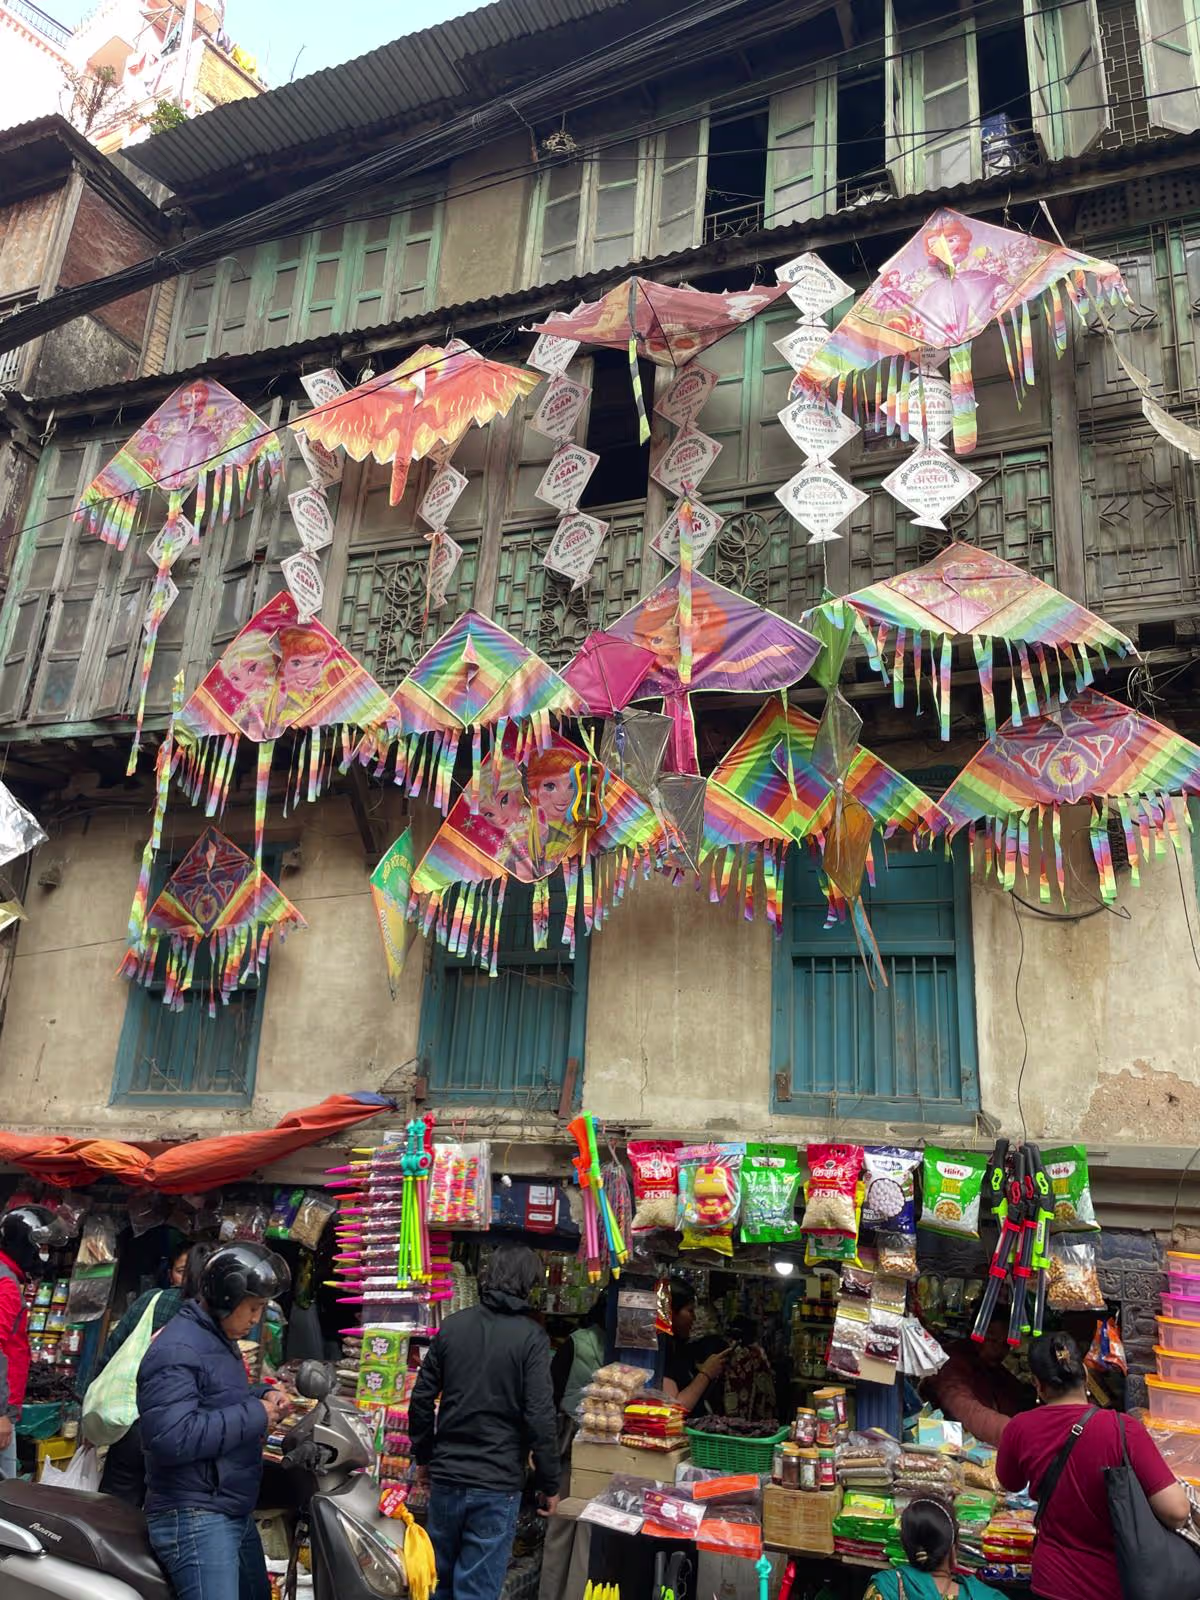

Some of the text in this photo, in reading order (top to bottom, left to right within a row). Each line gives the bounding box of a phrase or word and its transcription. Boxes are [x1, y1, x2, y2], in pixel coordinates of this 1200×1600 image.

[550, 396, 572, 415] ASAN
[912, 400, 946, 408] AAN
[575, 454, 587, 466] CENTER
[554, 463, 578, 482] ASAN
[432, 485, 450, 501] ASAN
[698, 513, 711, 527] CENTER
[296, 572, 315, 590] ASAN
